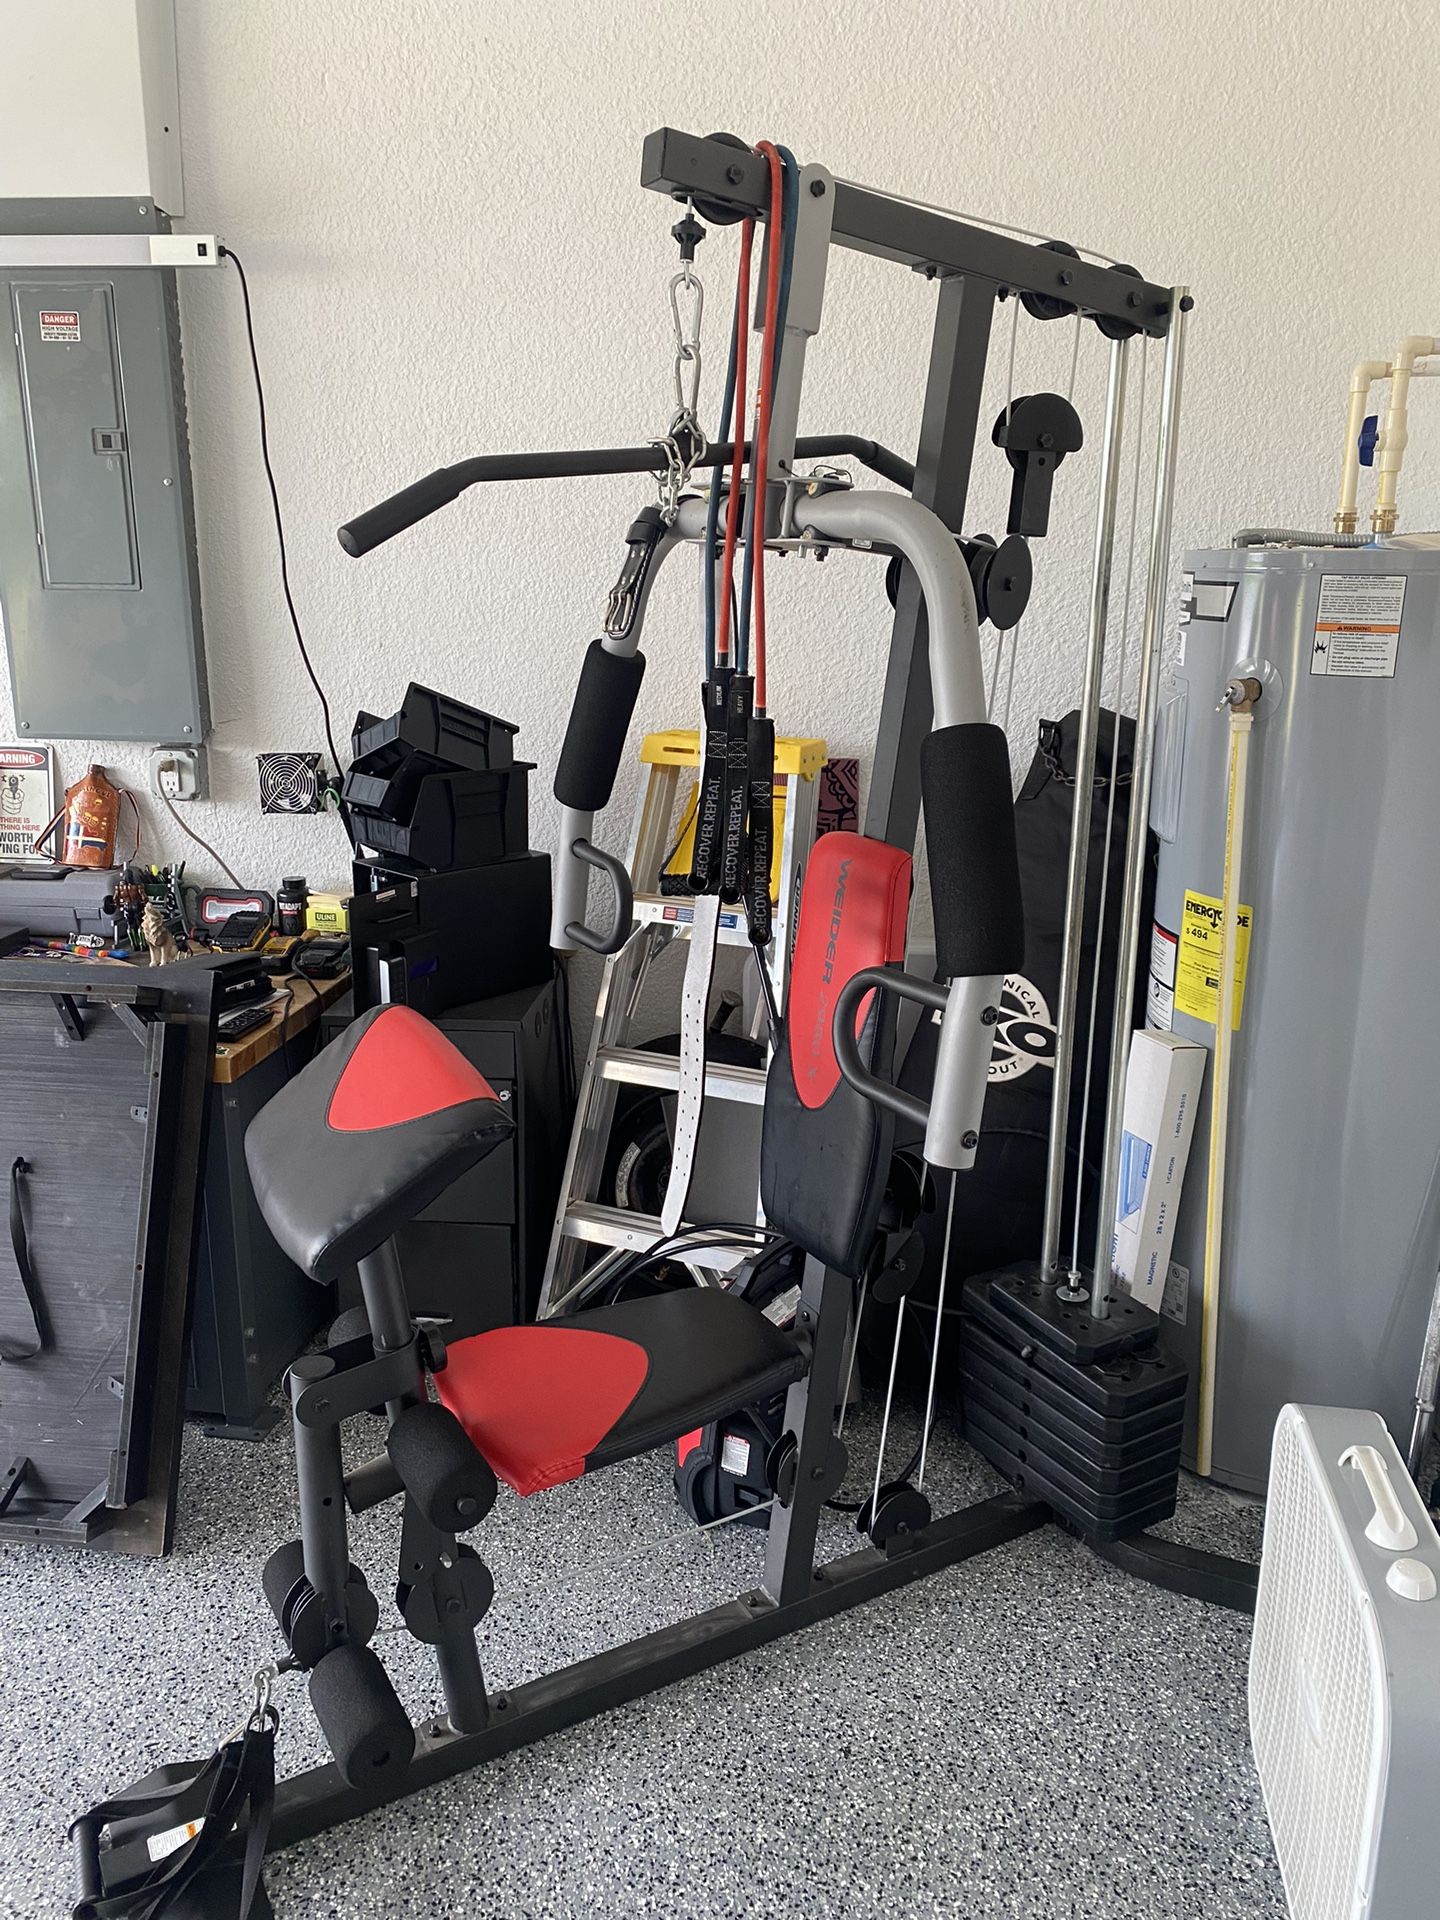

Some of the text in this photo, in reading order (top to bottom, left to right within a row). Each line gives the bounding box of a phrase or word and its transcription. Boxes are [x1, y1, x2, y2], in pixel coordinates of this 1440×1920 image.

[44, 315, 75, 323] DANGER
[0, 753, 35, 764] ARNING
[0, 816, 22, 824] THERE
[0, 832, 33, 843] WORTH
[316, 913, 336, 921] ULINE
[822, 858, 853, 985] WEIDER
[1191, 928, 1208, 940] 494
[1147, 1251, 1158, 1285] MAGNETIC
